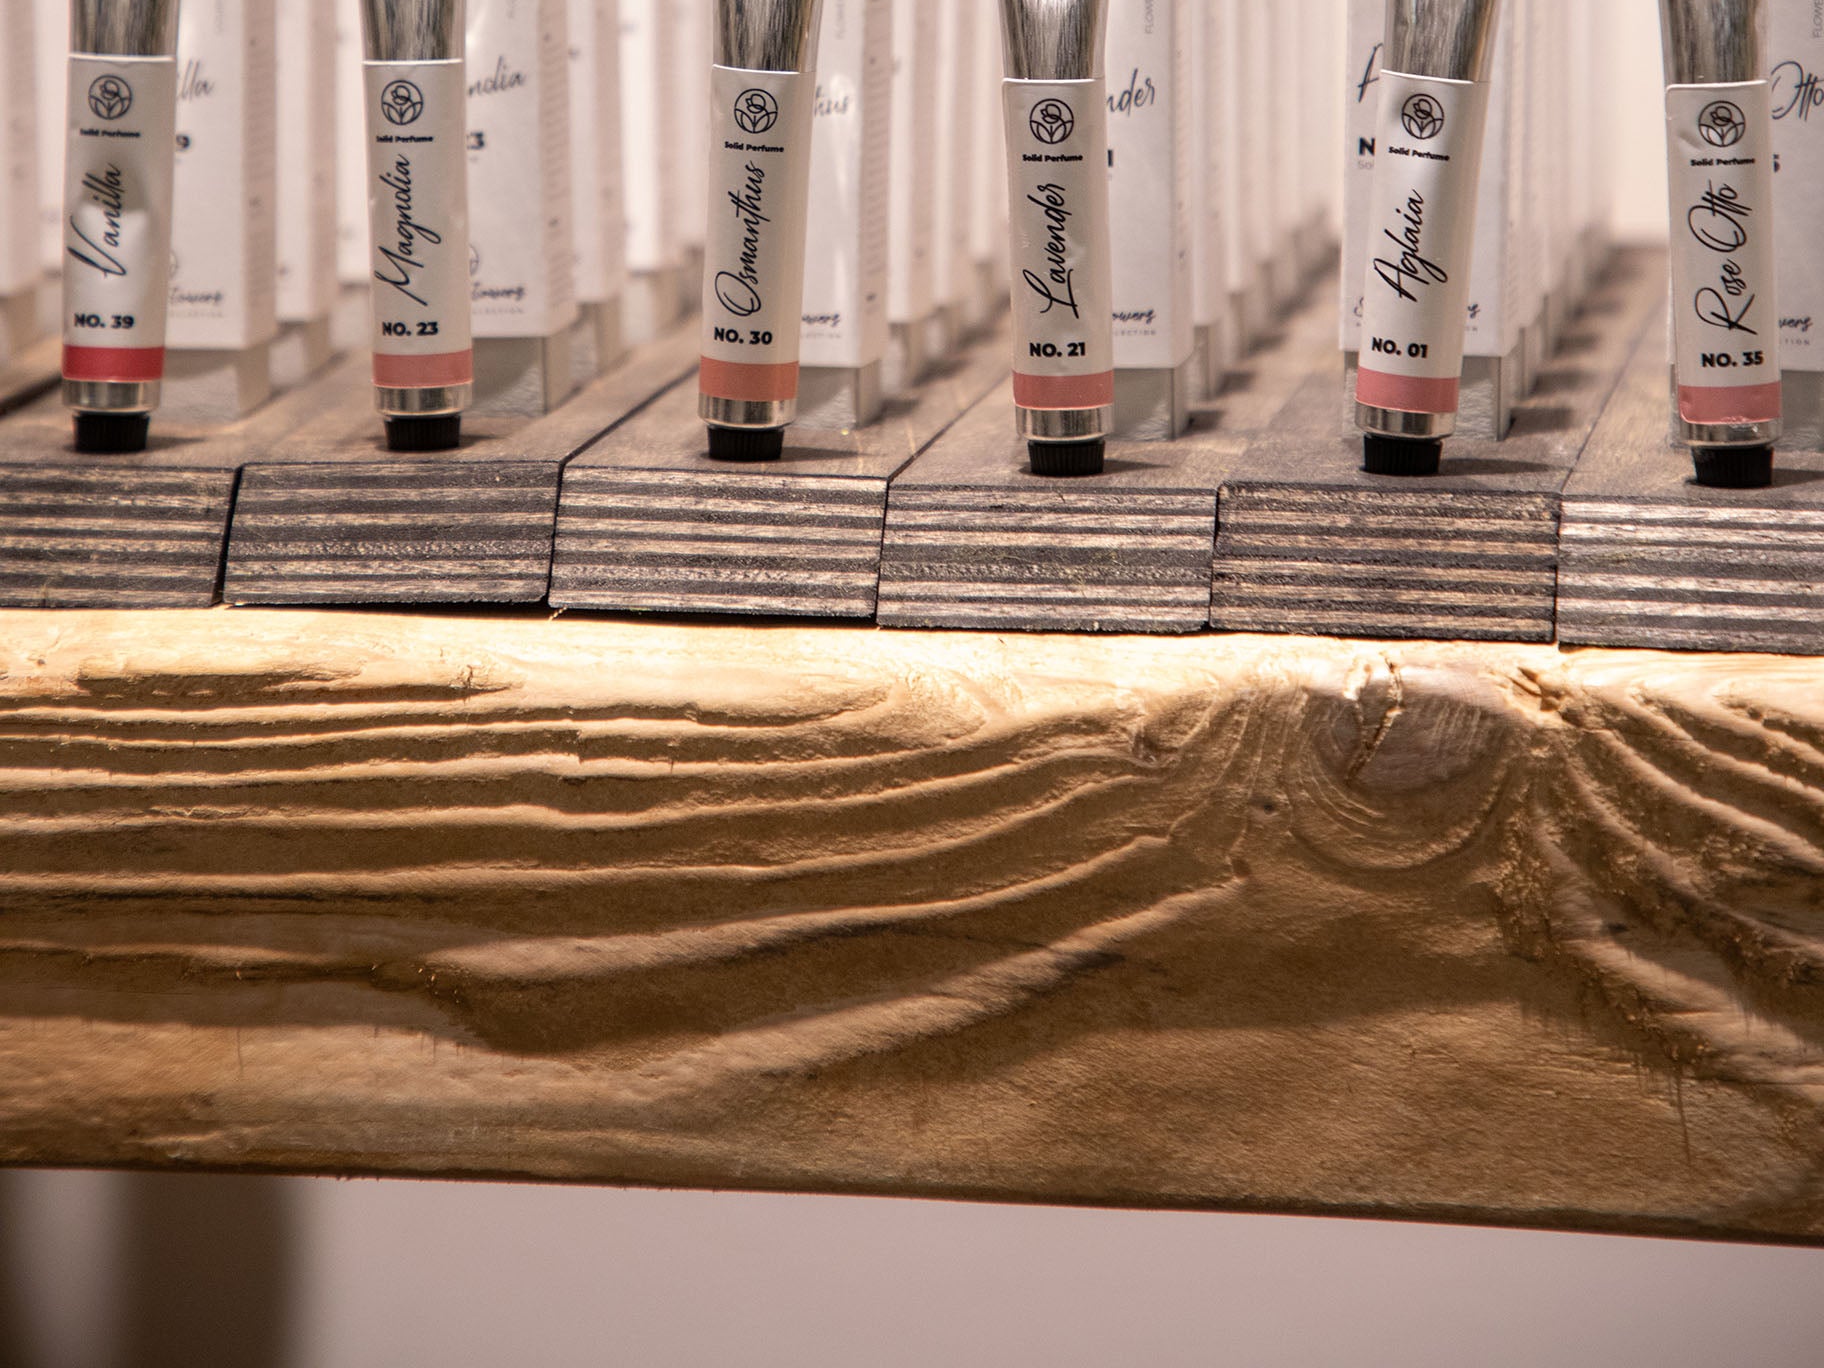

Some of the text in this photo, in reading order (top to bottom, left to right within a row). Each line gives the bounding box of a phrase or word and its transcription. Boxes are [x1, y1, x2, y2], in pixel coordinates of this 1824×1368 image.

[1107, 68, 1155, 117] nder
[724, 141, 784, 152] Solid Perfume
[1388, 146, 1450, 161] Solid Perfume
[1023, 154, 1083, 162] Solid Perfume
[1690, 157, 1755, 167] Solid Perfume
[67, 163, 127, 276] Vanilla
[374, 154, 441, 306] Magnolia
[714, 160, 771, 317] Osmanthus
[1022, 182, 1079, 319] Lavender
[1373, 189, 1448, 302] Aglaia
[1688, 179, 1758, 335] Rose Otto
[74, 314, 134, 329] NO. 39
[382, 322, 438, 336] NO. 23
[714, 327, 773, 345] NO. 30
[1029, 342, 1086, 357] NO. 21
[1372, 337, 1428, 358] NO. 01
[1701, 351, 1764, 368] NO. 35
